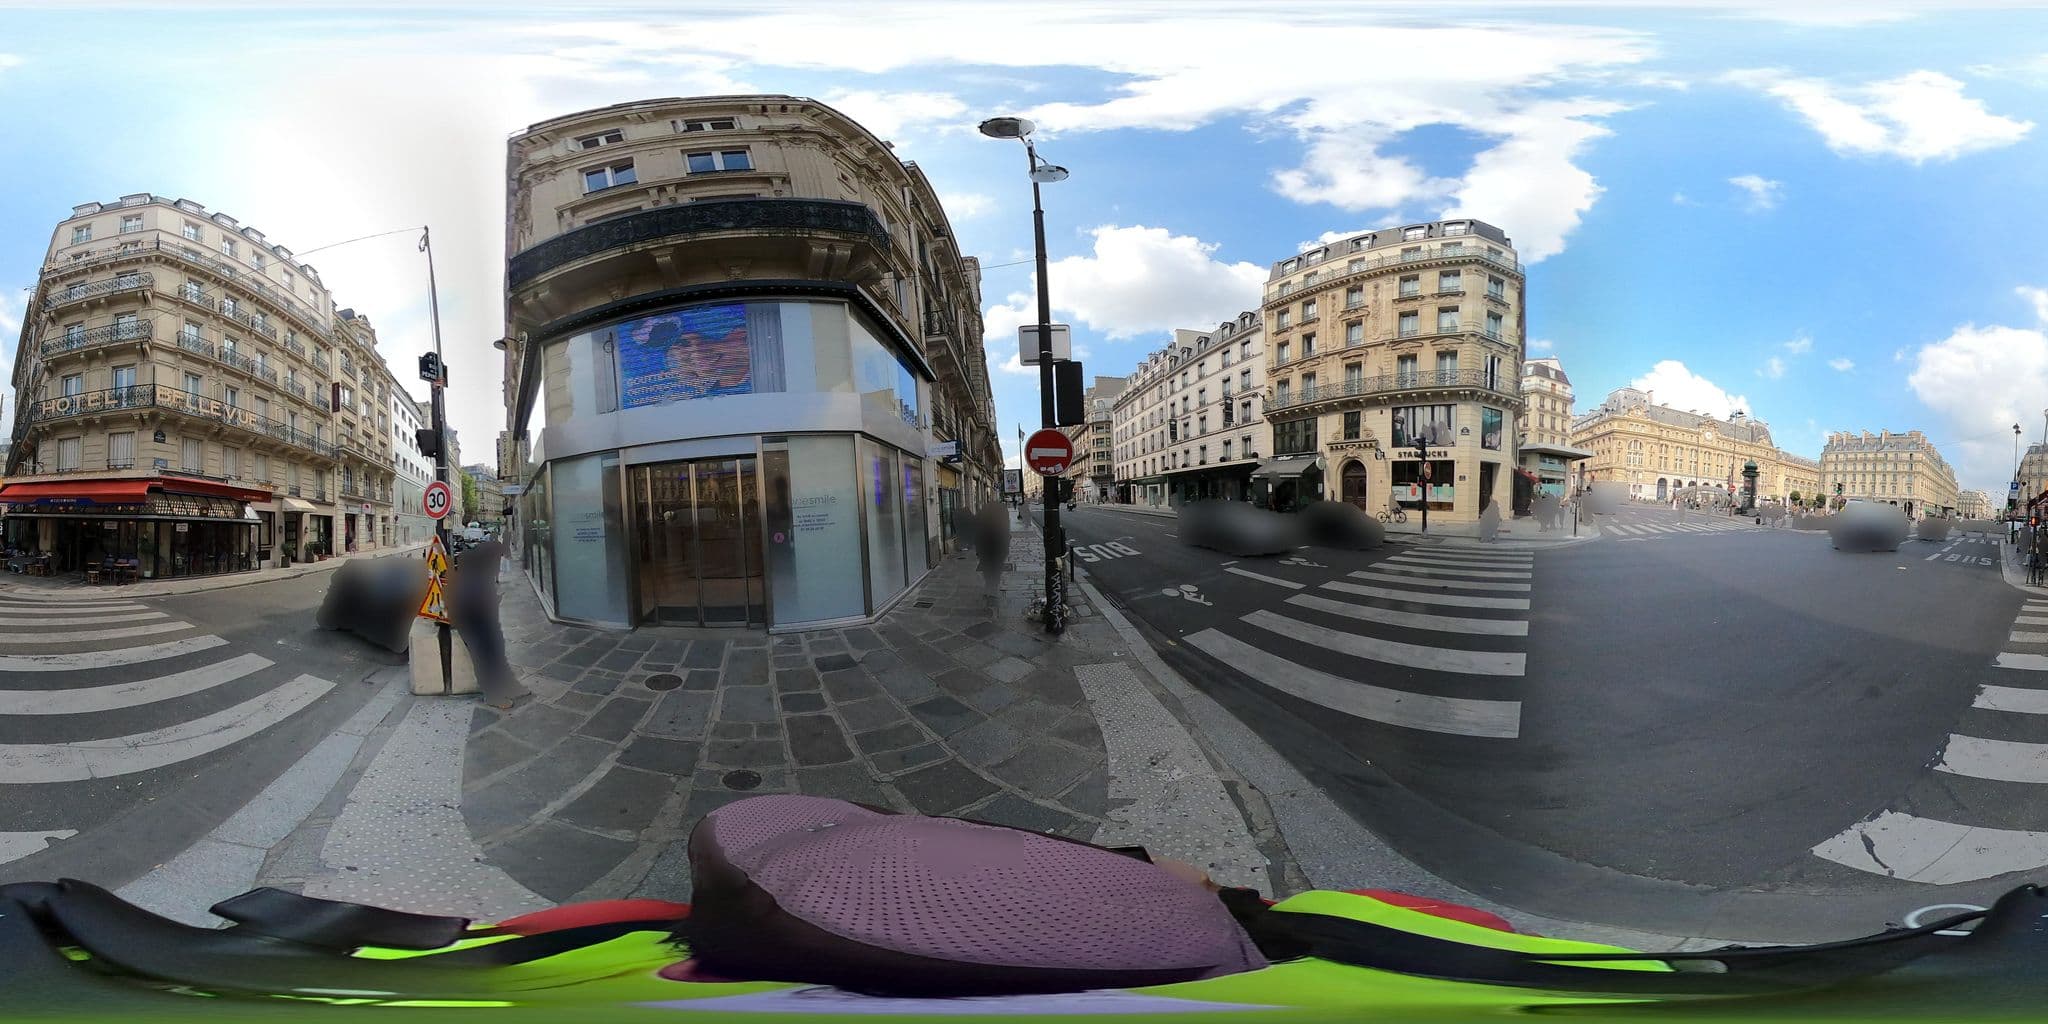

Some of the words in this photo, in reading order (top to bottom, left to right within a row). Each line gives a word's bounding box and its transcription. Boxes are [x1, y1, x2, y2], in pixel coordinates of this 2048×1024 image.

[43, 389, 118, 415] HOTEL
[156, 386, 257, 426] BELLEVUE
[429, 491, 446, 509] 30
[1073, 541, 1142, 562] BUS
[1944, 553, 1993, 566] BUS
